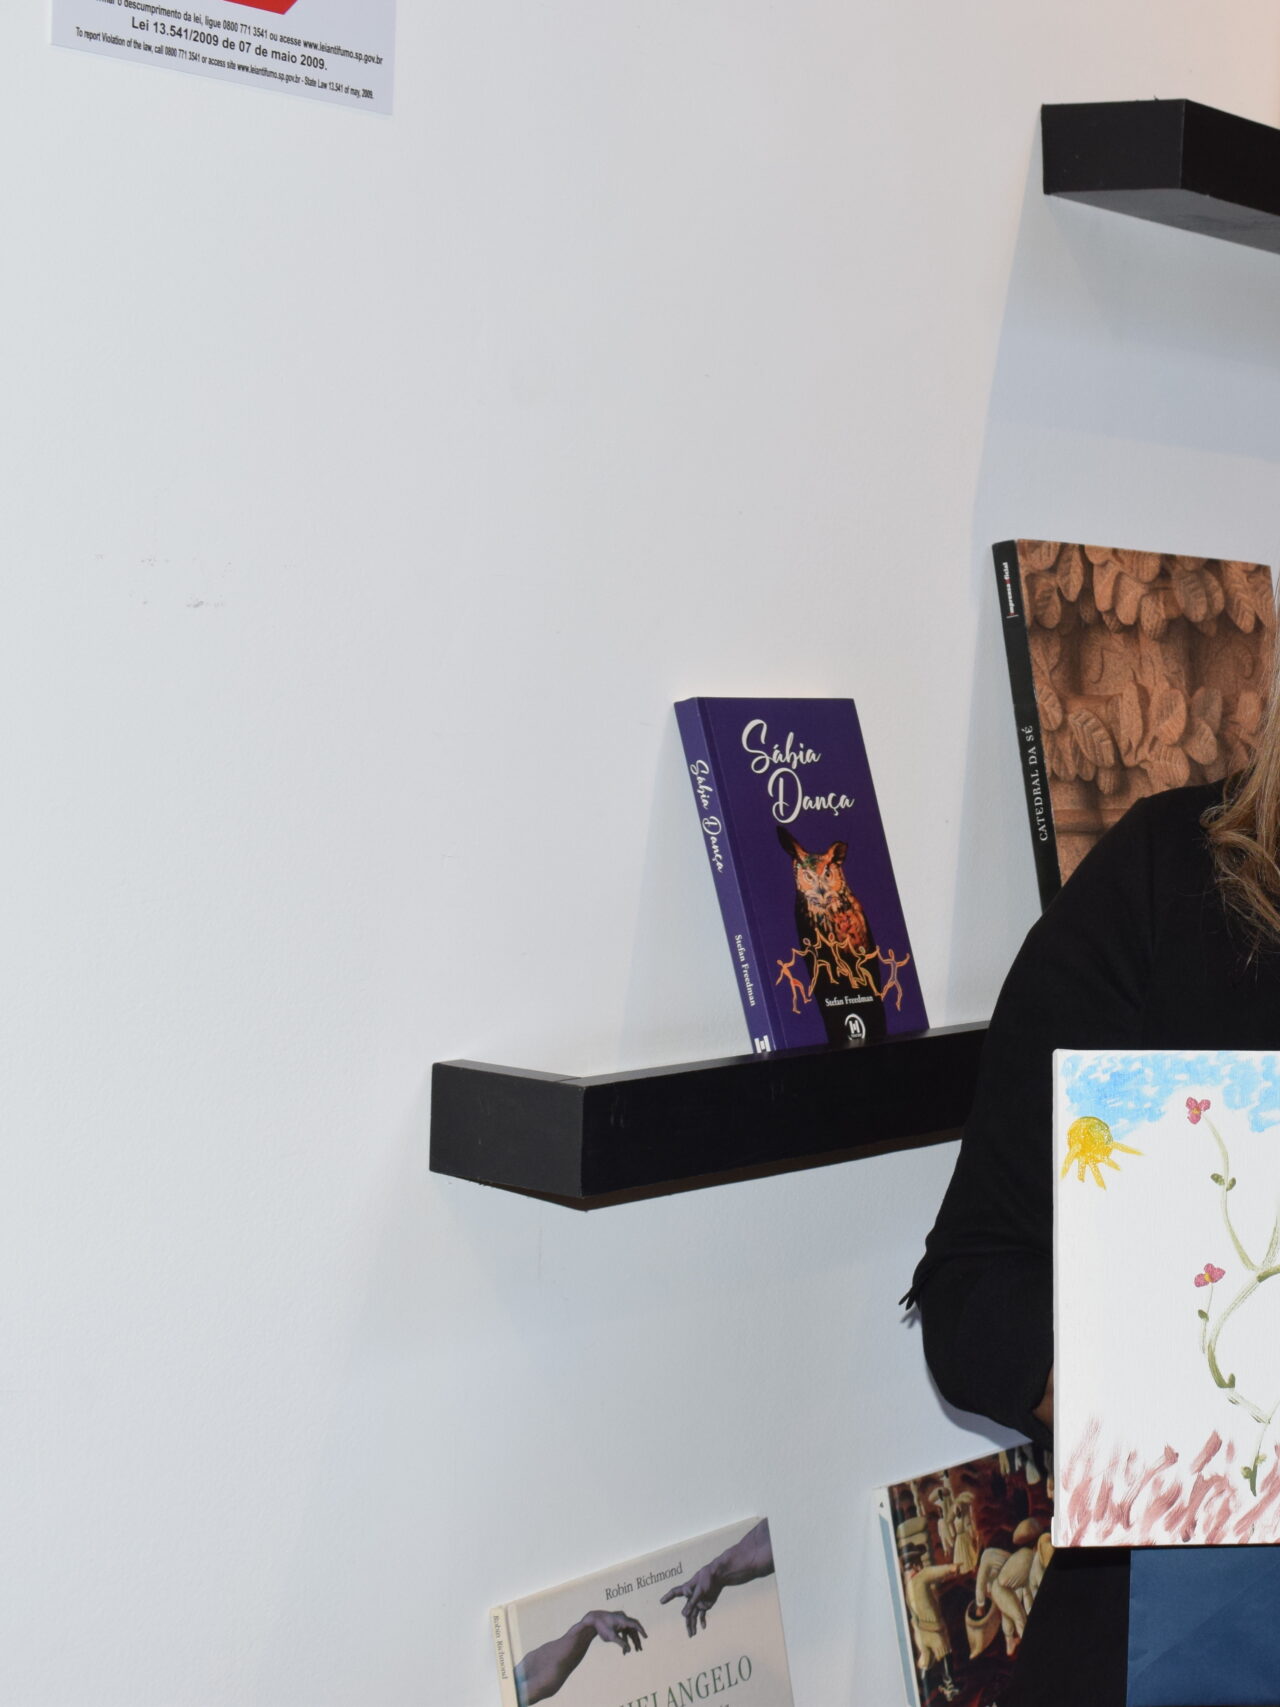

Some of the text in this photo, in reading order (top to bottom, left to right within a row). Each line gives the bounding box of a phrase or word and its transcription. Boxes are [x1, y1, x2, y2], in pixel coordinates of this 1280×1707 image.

[84, 30, 101, 42] report
[102, 31, 126, 46] Violation
[134, 39, 142, 50] the
[154, 44, 164, 54] call
[164, 46, 178, 58] 0800
[178, 48, 188, 59] 771
[188, 50, 200, 62] 3541
[208, 56, 226, 68] access
[227, 60, 236, 70] site
[124, 0, 182, 20] descumprimento
[183, 11, 192, 22] da
[193, 12, 204, 26] lei,
[205, 15, 221, 29] ligue
[222, 19, 238, 33] 0800
[240, 23, 251, 36] 771
[253, 26, 268, 39] 3541
[269, 32, 278, 42] ou
[280, 34, 302, 46] acesse
[303, 40, 384, 64] www.leiantifumo.sp.gov.br
[131, 16, 328, 71] Lei 13.541/2009 de 07 de maio 2009.
[741, 719, 821, 774] Sábia
[767, 767, 856, 824] Dança
[1021, 725, 1048, 841] CATEDRAL DA SÉ
[690, 759, 724, 873] Sábia Dança
[734, 934, 756, 1007] Stefan Freedman
[824, 994, 874, 1007] Stefan Freedman
[605, 1562, 684, 1600] Robin Richmond
